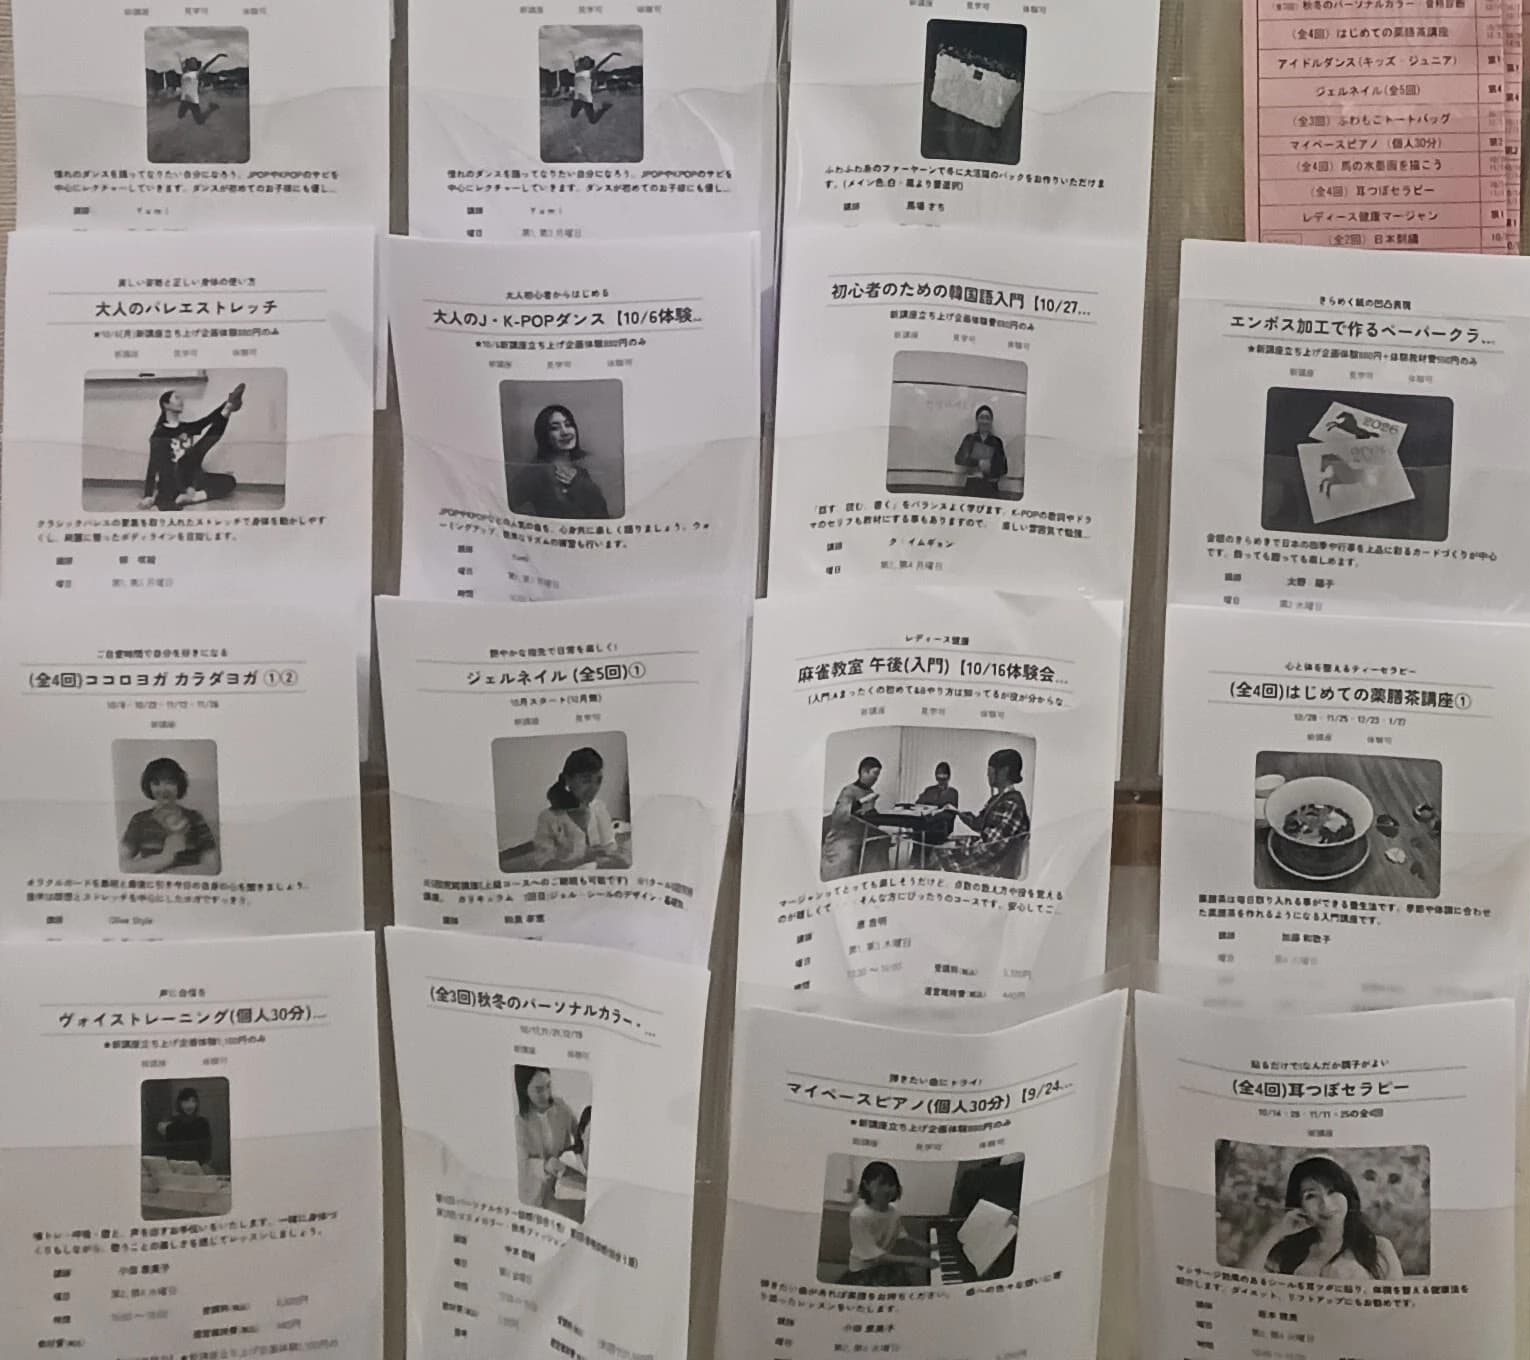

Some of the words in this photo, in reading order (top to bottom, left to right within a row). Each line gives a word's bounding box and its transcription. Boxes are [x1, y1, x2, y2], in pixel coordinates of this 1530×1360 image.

[95, 299, 279, 318] 大人のバレエストレッチ
[174, 669, 259, 687] カラダヨガ
[797, 657, 865, 684] 麻雀教室
[1232, 1079, 1409, 1098] (全4回)耳つぼセラピー
